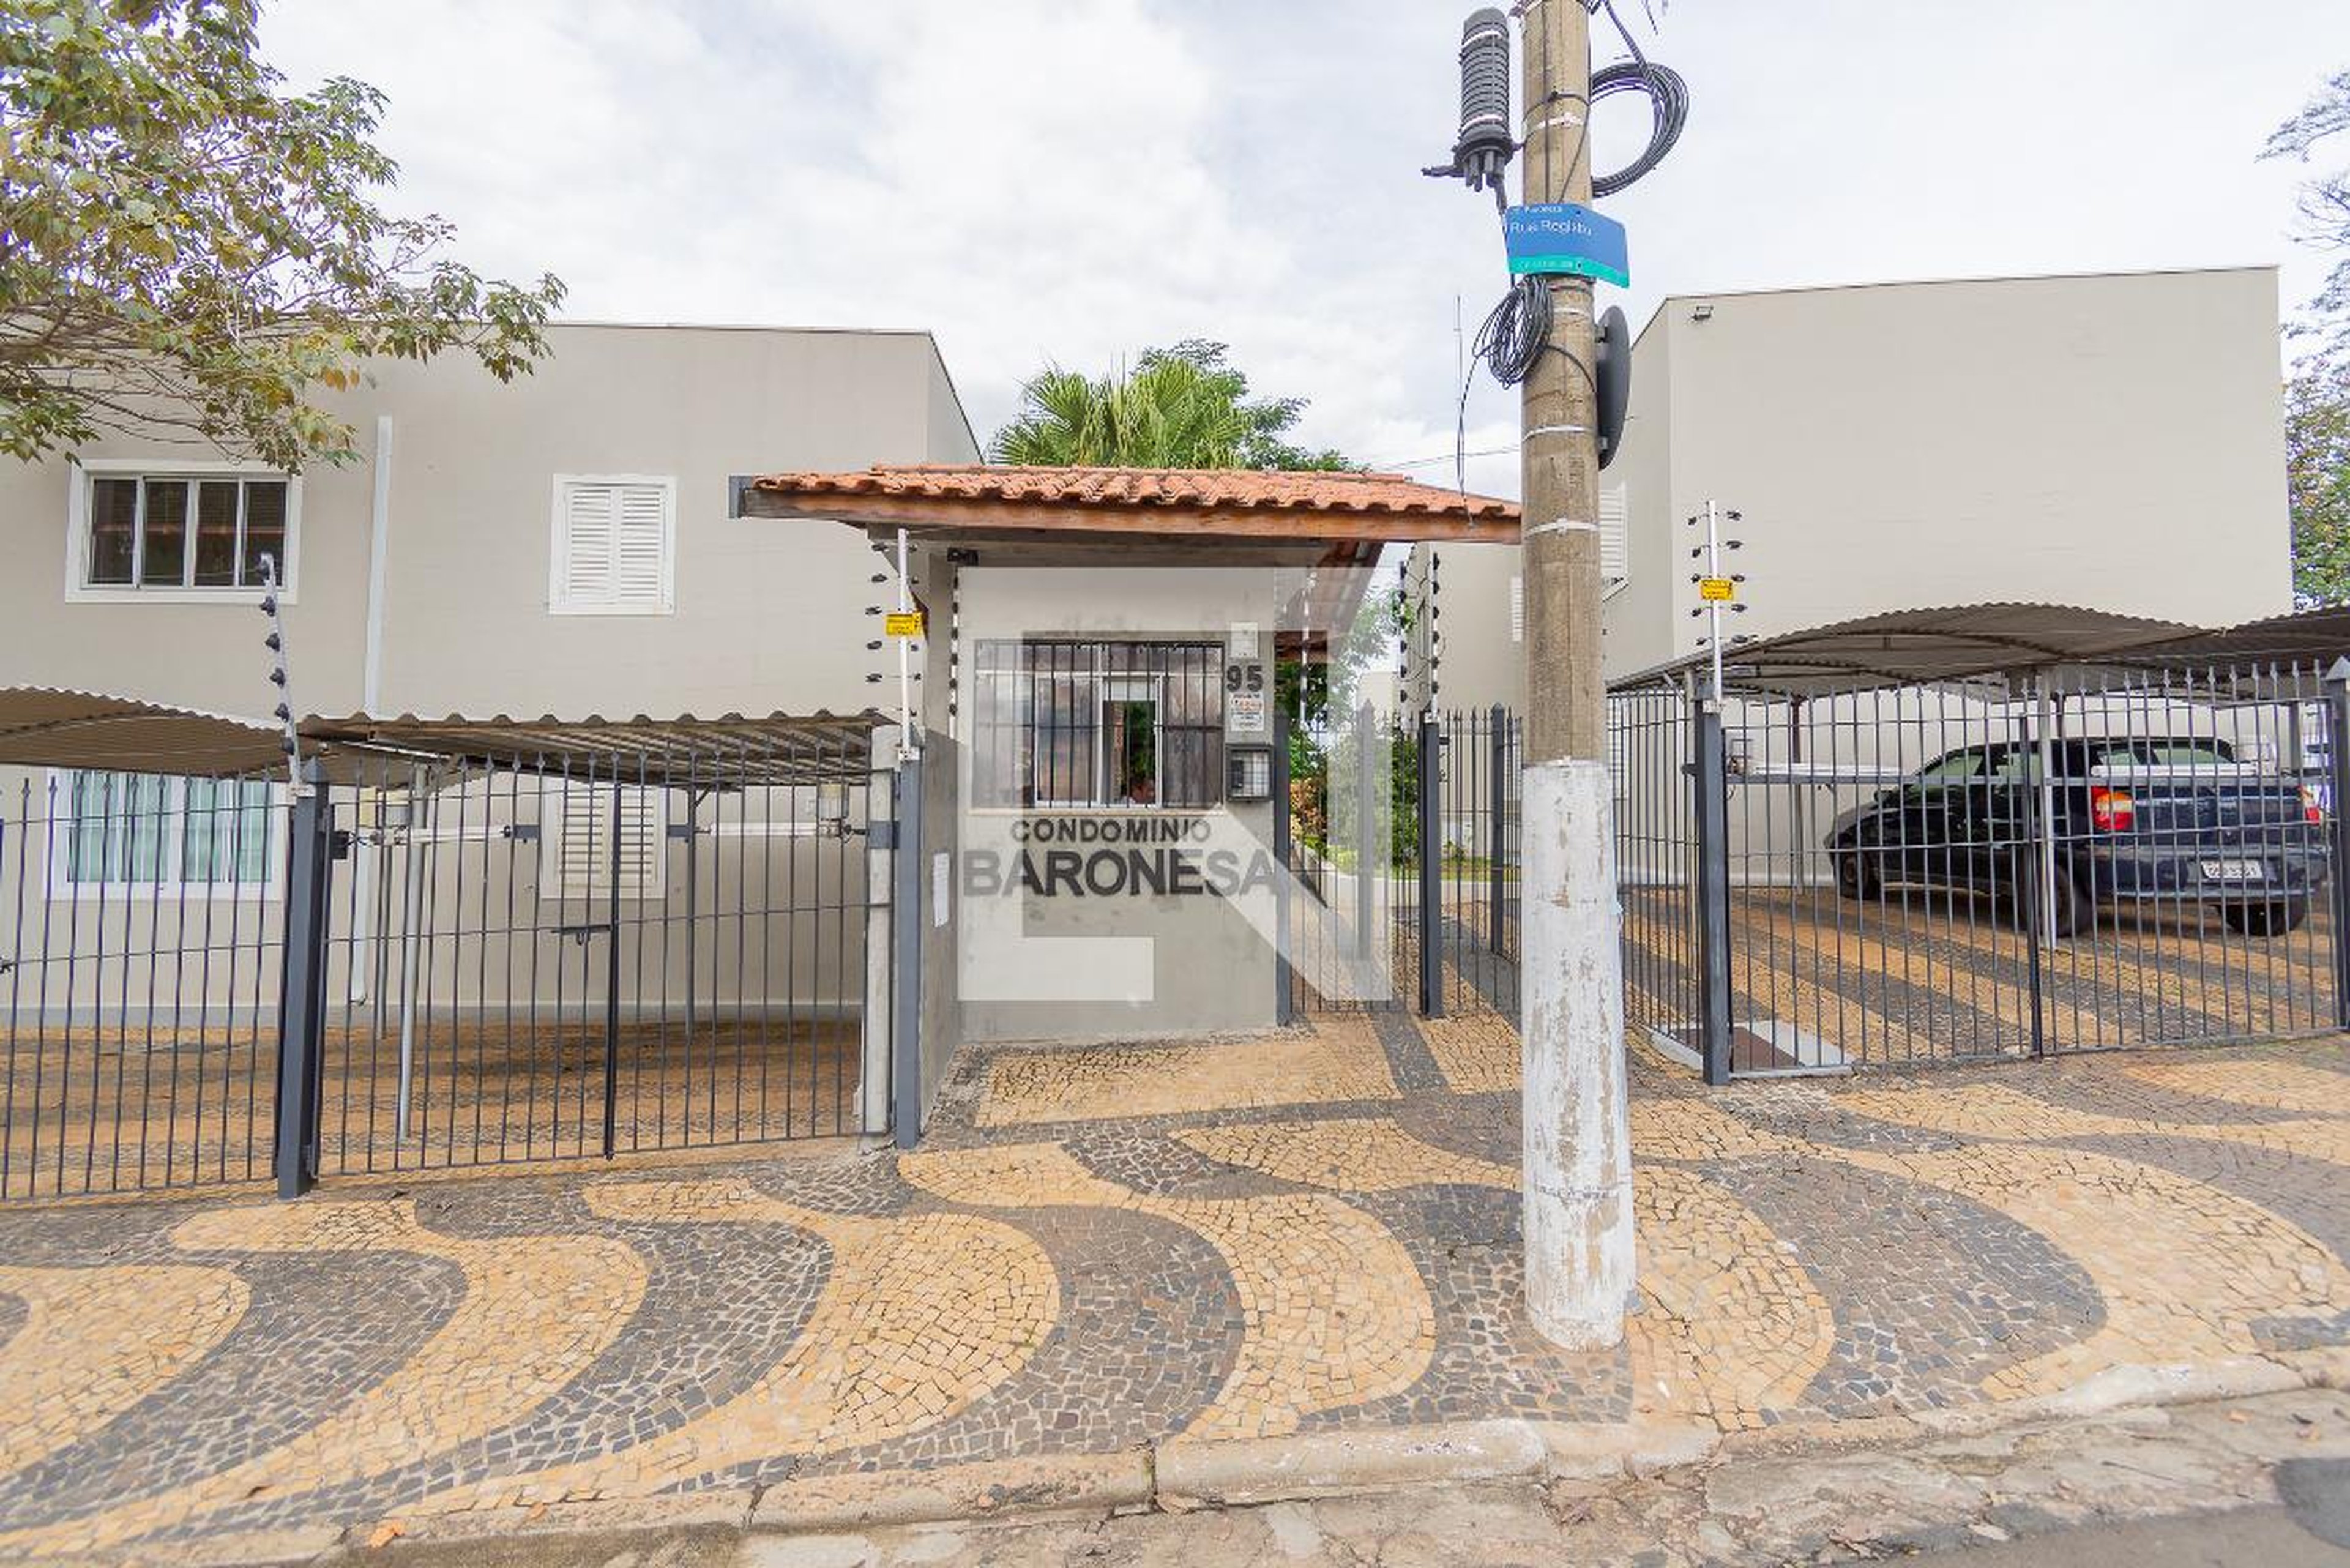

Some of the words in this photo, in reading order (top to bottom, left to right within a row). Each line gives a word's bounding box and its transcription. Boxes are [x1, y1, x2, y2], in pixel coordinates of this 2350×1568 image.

[1227, 665, 1263, 692] 95
[1012, 819, 1211, 842] CONDOMINIO
[963, 849, 1281, 897] BARONESA
